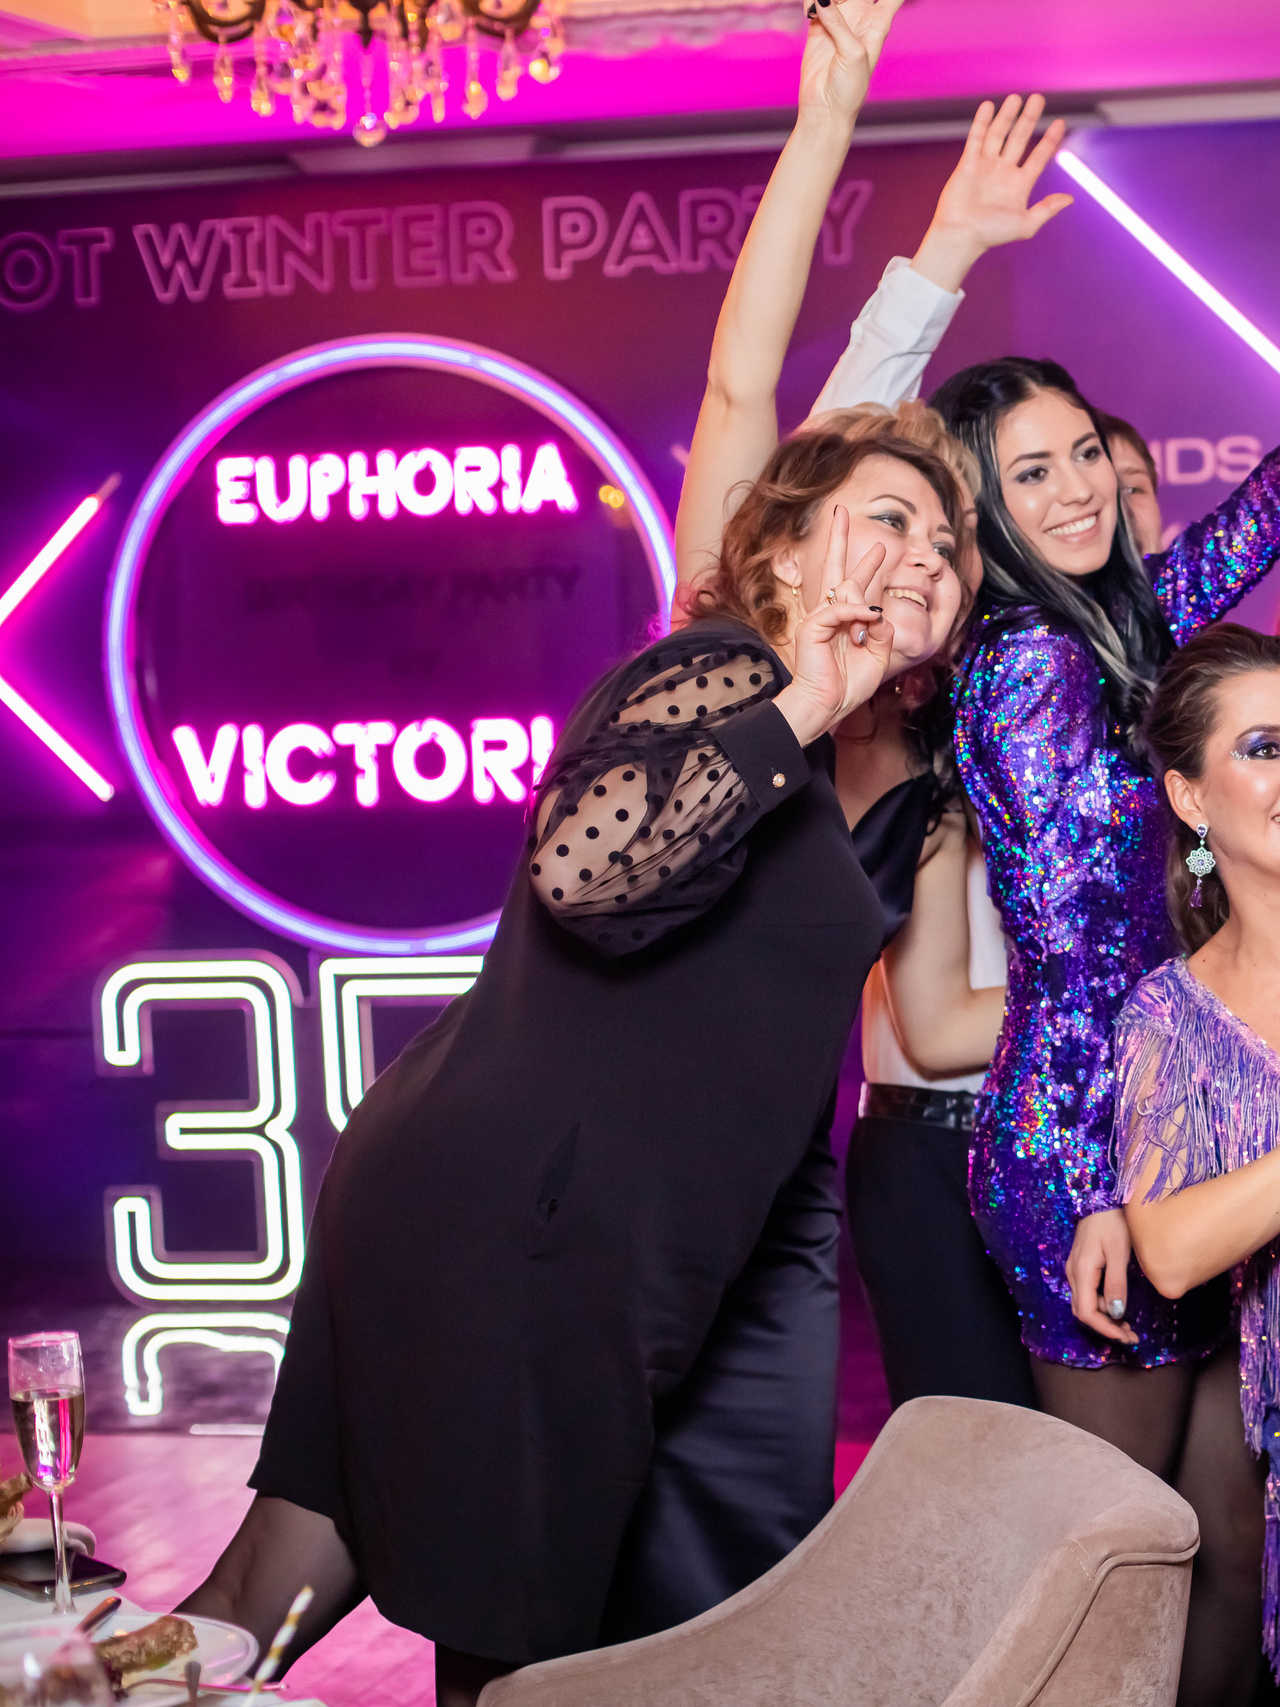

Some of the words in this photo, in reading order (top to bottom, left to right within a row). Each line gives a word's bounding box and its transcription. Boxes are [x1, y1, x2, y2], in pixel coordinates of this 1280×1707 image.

[131, 199, 518, 306] WINTER
[541, 178, 874, 281] PARY
[215, 441, 579, 526] EUPHORIA
